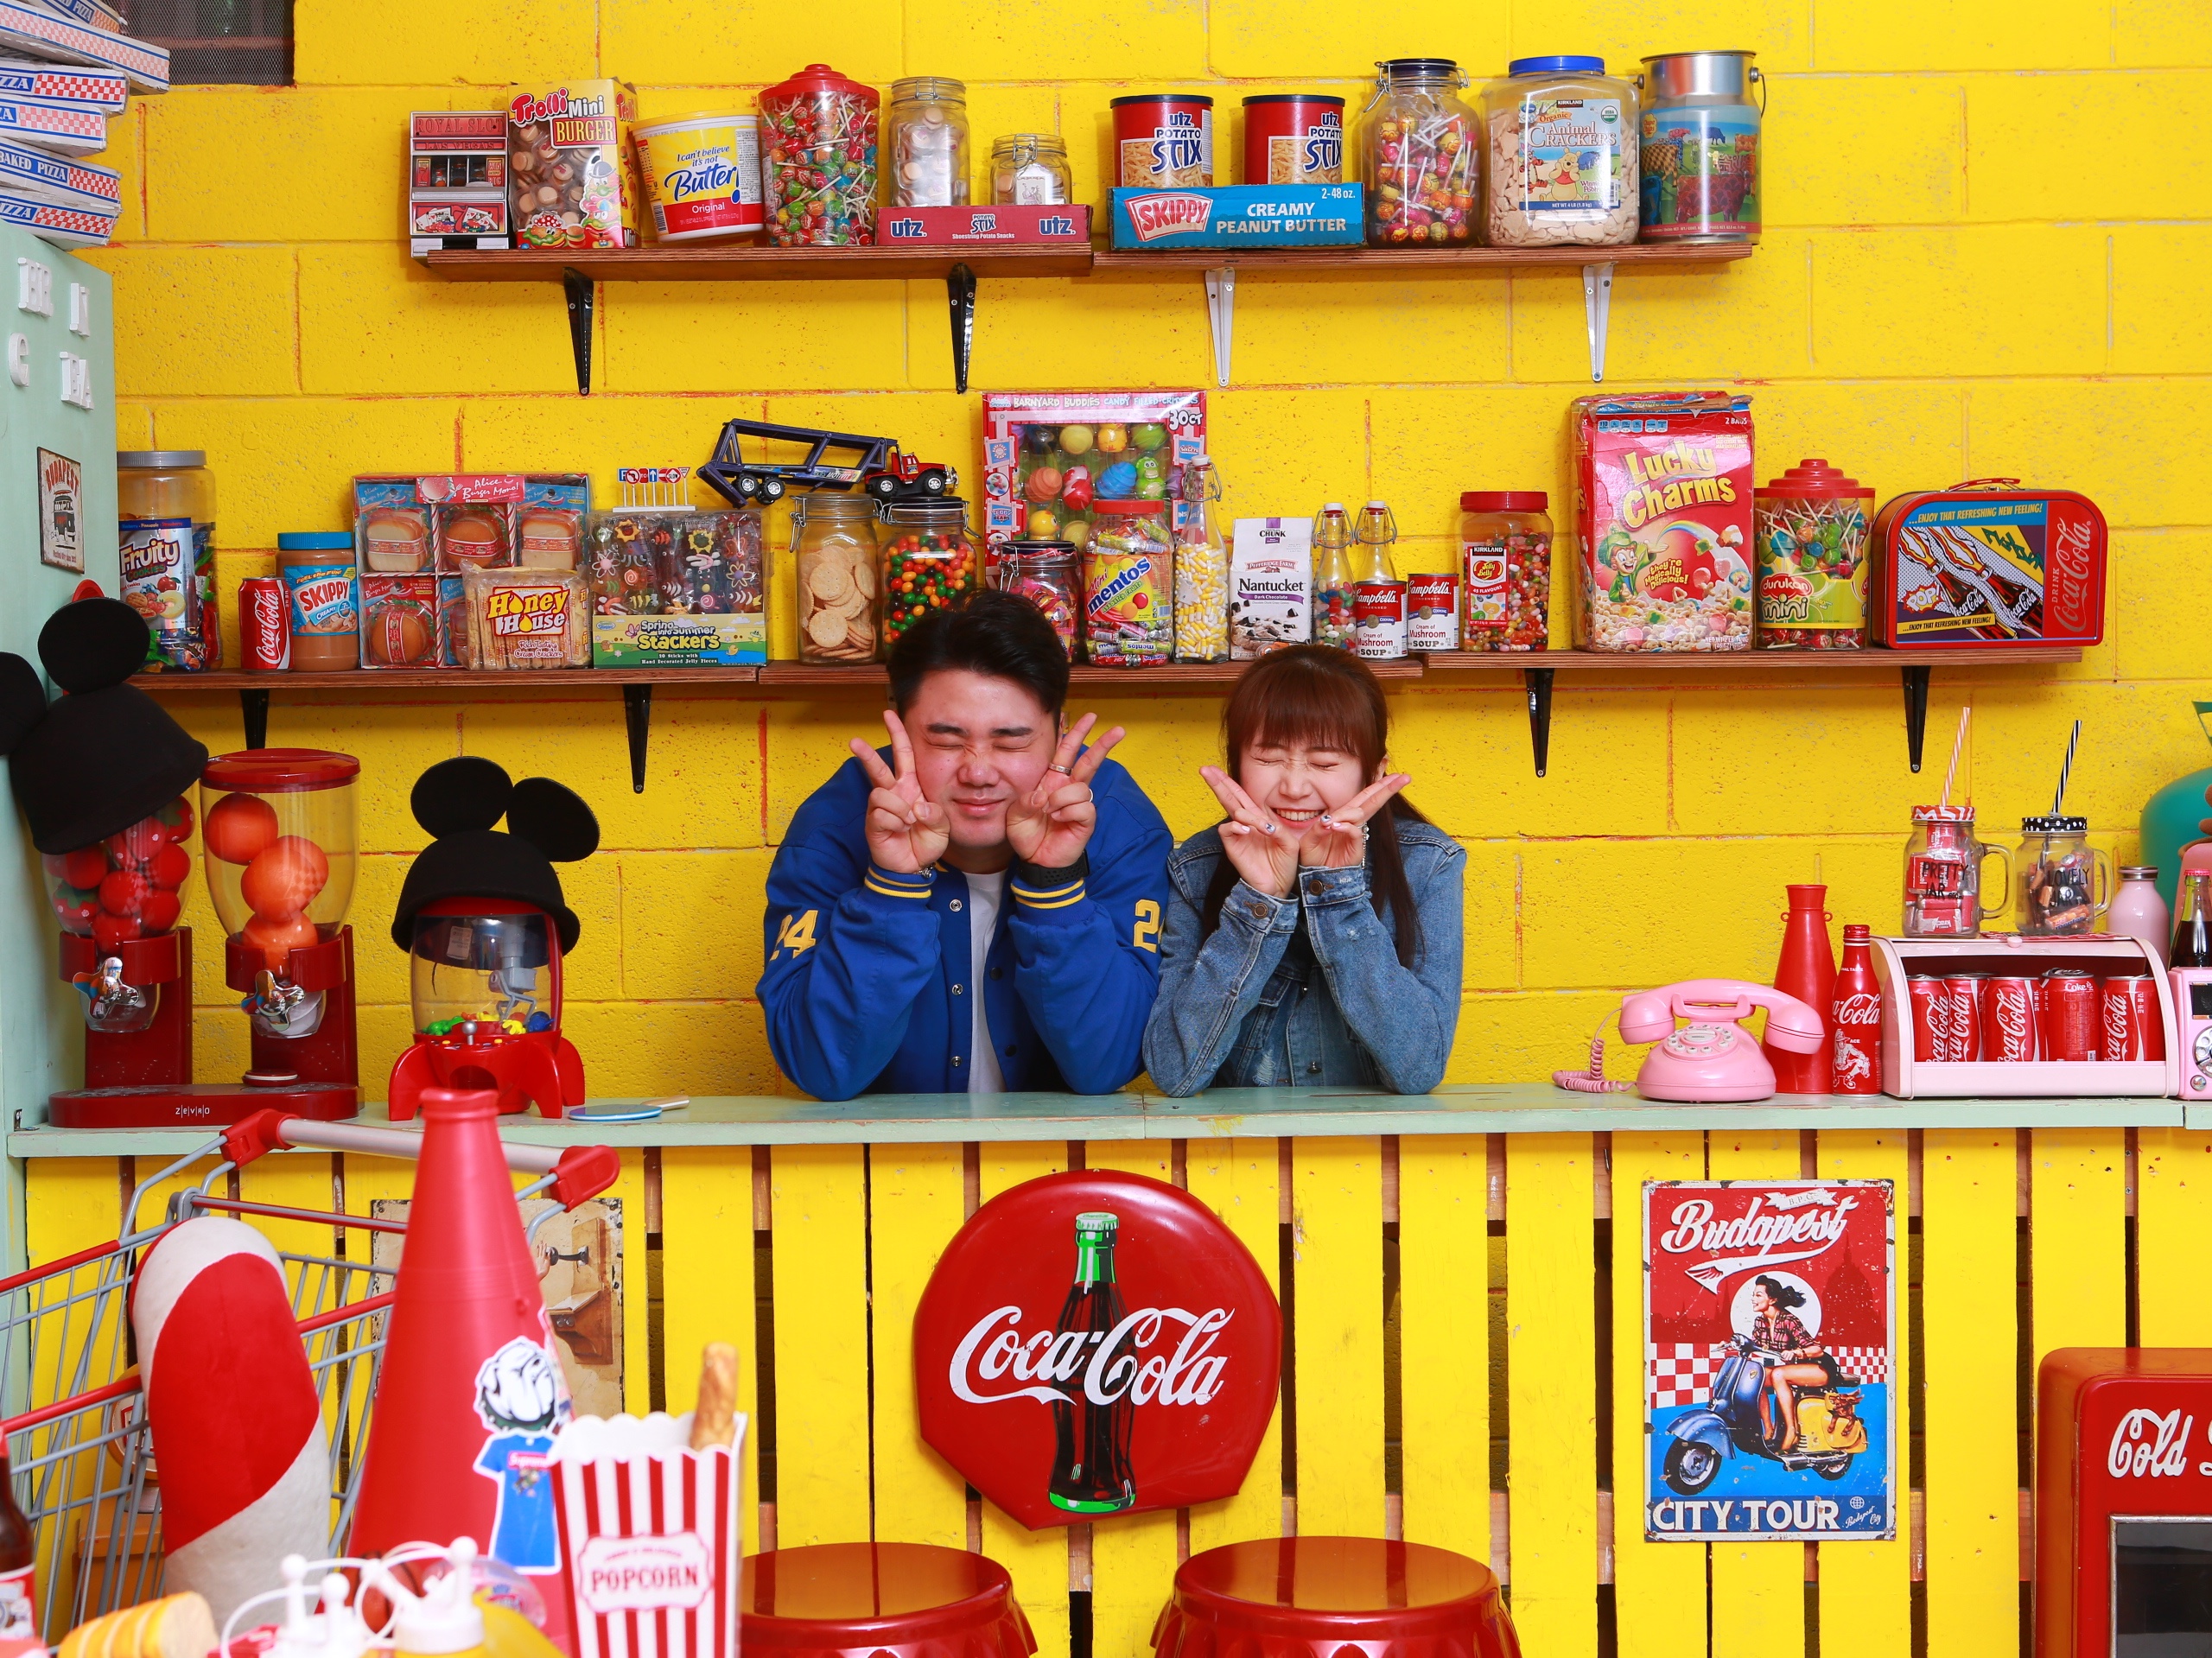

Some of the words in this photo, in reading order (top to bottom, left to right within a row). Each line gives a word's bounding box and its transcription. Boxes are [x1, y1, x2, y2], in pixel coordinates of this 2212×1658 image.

[510, 86, 569, 125] Trolli
[568, 94, 605, 118] Mini
[416, 118, 463, 133] ROYAL
[468, 118, 504, 133] SLOT
[1539, 111, 1568, 123] Organic
[556, 119, 614, 143] BURGER
[1156, 129, 1202, 139] POTATO
[1528, 125, 1618, 148] CRACKERS
[1546, 121, 1597, 135] Animal
[454, 142, 495, 150] VEGAS
[681, 149, 701, 161] can't
[702, 145, 730, 156] believe
[692, 158, 703, 168] it's
[704, 155, 719, 164] not
[1151, 139, 1203, 173] STIX
[37, 162, 67, 181] PIZZA
[691, 201, 726, 214] Original
[1138, 199, 1207, 232] SKIPPY
[1247, 201, 1316, 218] CREAMY
[969, 219, 995, 234] STIX
[1216, 219, 1280, 234] PEANUT
[1285, 217, 1347, 232] BUTTER
[1014, 397, 1060, 408] BARNYARD
[1064, 397, 1101, 407] BUDDIES
[1103, 397, 1130, 406] CANDY
[1169, 409, 1204, 431] 30CT
[1624, 440, 1718, 486] Lucky
[45, 459, 79, 498] BUDAPEST
[462, 487, 491, 500] Burger
[1623, 476, 1738, 529] Charms
[1939, 511, 1955, 521] THAT
[1956, 506, 1997, 520] REFRESHING
[1998, 505, 2013, 516] NEW
[2014, 502, 2044, 515] FEELING!
[120, 540, 180, 575] Fruity
[1249, 561, 1279, 569] PEPPERIDGE
[1482, 562, 1496, 571] Jelly
[1649, 558, 1682, 575] they're
[1089, 567, 1109, 592] Mini
[1477, 569, 1493, 577] Belly
[1644, 566, 1681, 586] Magically
[1649, 574, 1689, 591] Delicious!
[2054, 517, 2092, 632] Coca-Cola
[1087, 557, 1152, 616] mentos
[1124, 580, 1144, 599] FRUITS
[1239, 577, 1304, 592] Nantucket
[1479, 584, 1503, 594] FLAVOURS
[1761, 575, 1809, 591] durukan
[2051, 567, 2060, 604] DRINK
[299, 581, 349, 612] SKIPPY
[487, 590, 569, 619] Honey
[1763, 592, 1808, 619] mini
[1906, 582, 1941, 613] POP!
[316, 606, 336, 620] CREAMY
[254, 588, 282, 665] Coca-Cola
[501, 613, 566, 635] House
[641, 619, 674, 632] Spring
[672, 625, 715, 636] Summer
[1923, 621, 1934, 630] THAT
[1934, 619, 1961, 628] REFRESHING
[1972, 616, 1991, 626] FEELING!
[637, 634, 721, 651] Stackers
[1409, 629, 1446, 638] Mushroom
[513, 648, 535, 658] Cream
[535, 648, 564, 658] Crackers
[1923, 861, 1969, 880] PRETTY
[1925, 880, 1945, 899] JAR
[2064, 982, 2087, 992] Coke
[1660, 1195, 1860, 1257] Budapest
[949, 1304, 1236, 1407] Coca-Cola
[2107, 1407, 2193, 1478] Cold
[1652, 1500, 1735, 1531] CITY
[1742, 1500, 1841, 1531] TOUR
[1845, 1505, 1876, 1528] Budapest
[1869, 1512, 1882, 1525] City
[591, 1562, 699, 1592] POPCORN
